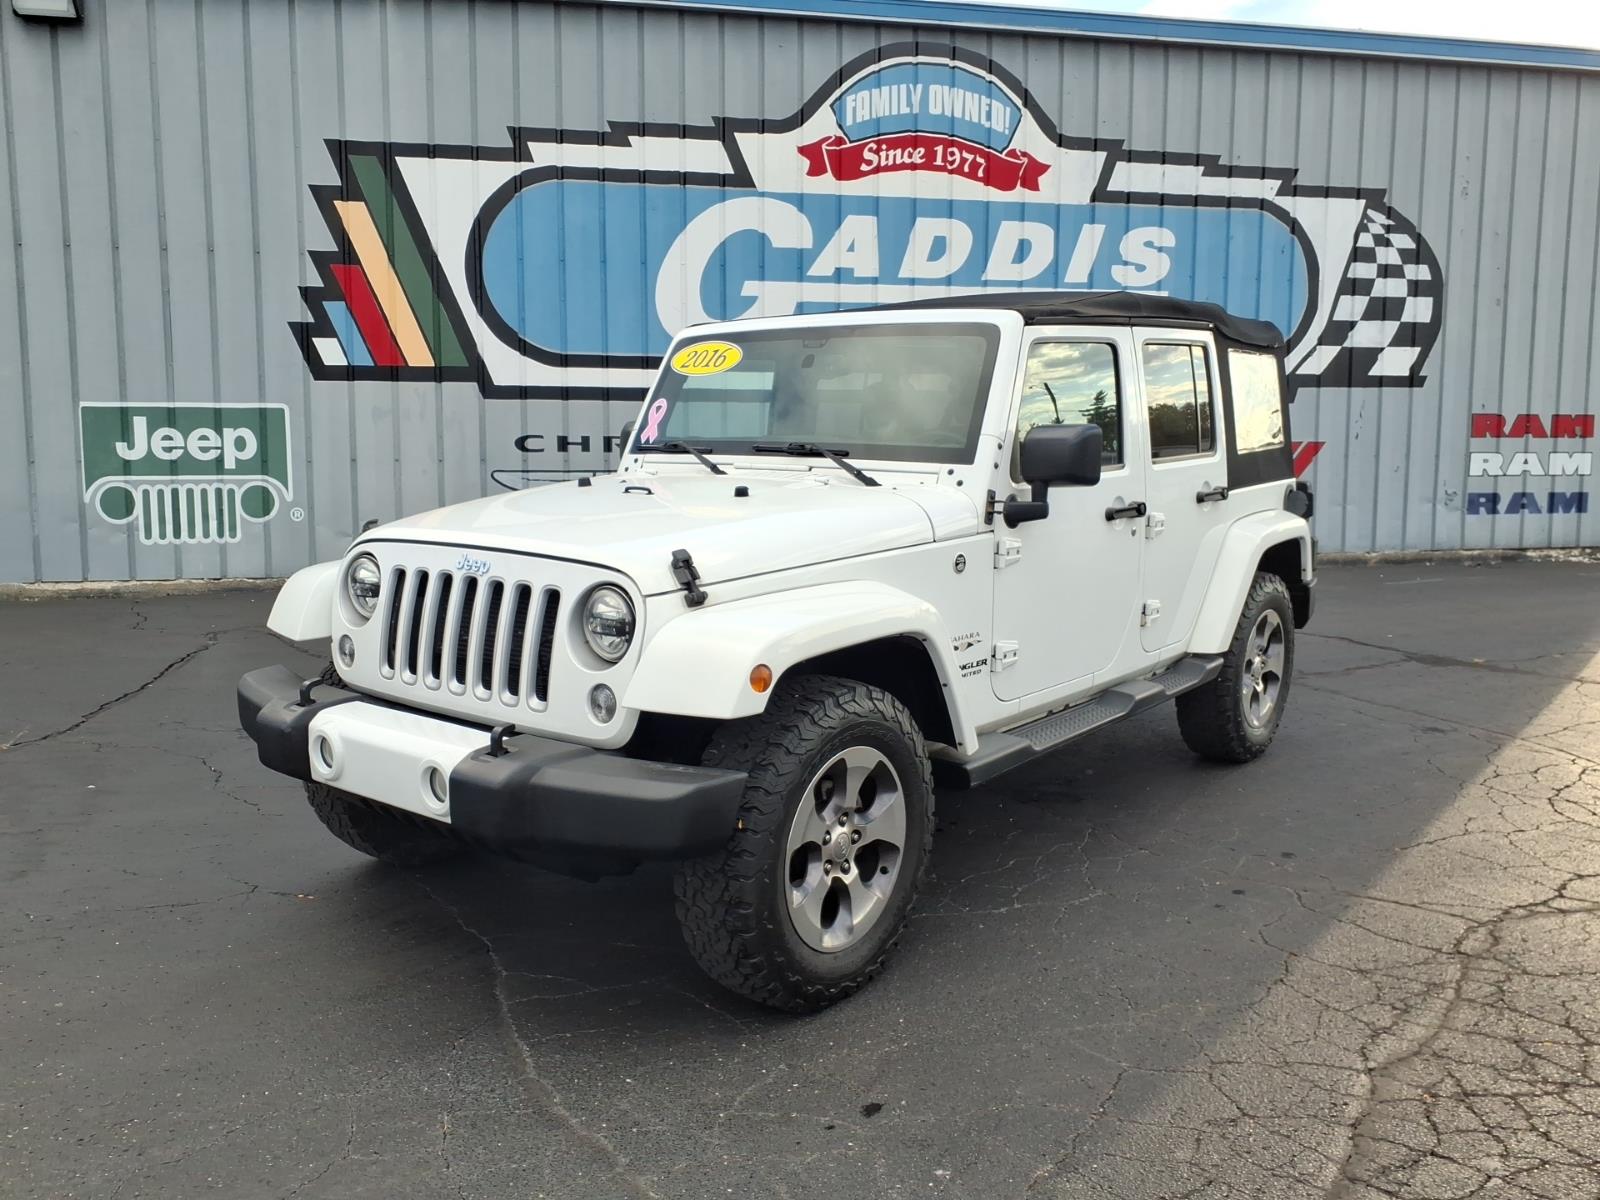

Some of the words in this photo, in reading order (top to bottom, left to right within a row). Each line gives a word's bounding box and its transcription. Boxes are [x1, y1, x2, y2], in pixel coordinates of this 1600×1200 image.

[845, 83, 923, 127] FAMILY
[928, 84, 1011, 135] OWNED!
[859, 143, 925, 172] Since
[932, 145, 986, 177] 1977
[655, 197, 1176, 337] GADDIS
[680, 347, 733, 368] 2016
[1471, 413, 1595, 438] RAM
[115, 416, 258, 469] Jeep
[514, 434, 621, 453] CHR
[1468, 452, 1592, 477] RAM
[1466, 492, 1589, 515] RAM
[456, 553, 491, 577] Jeep
[952, 631, 981, 643] AHARA
[959, 658, 988, 671] NGLER
